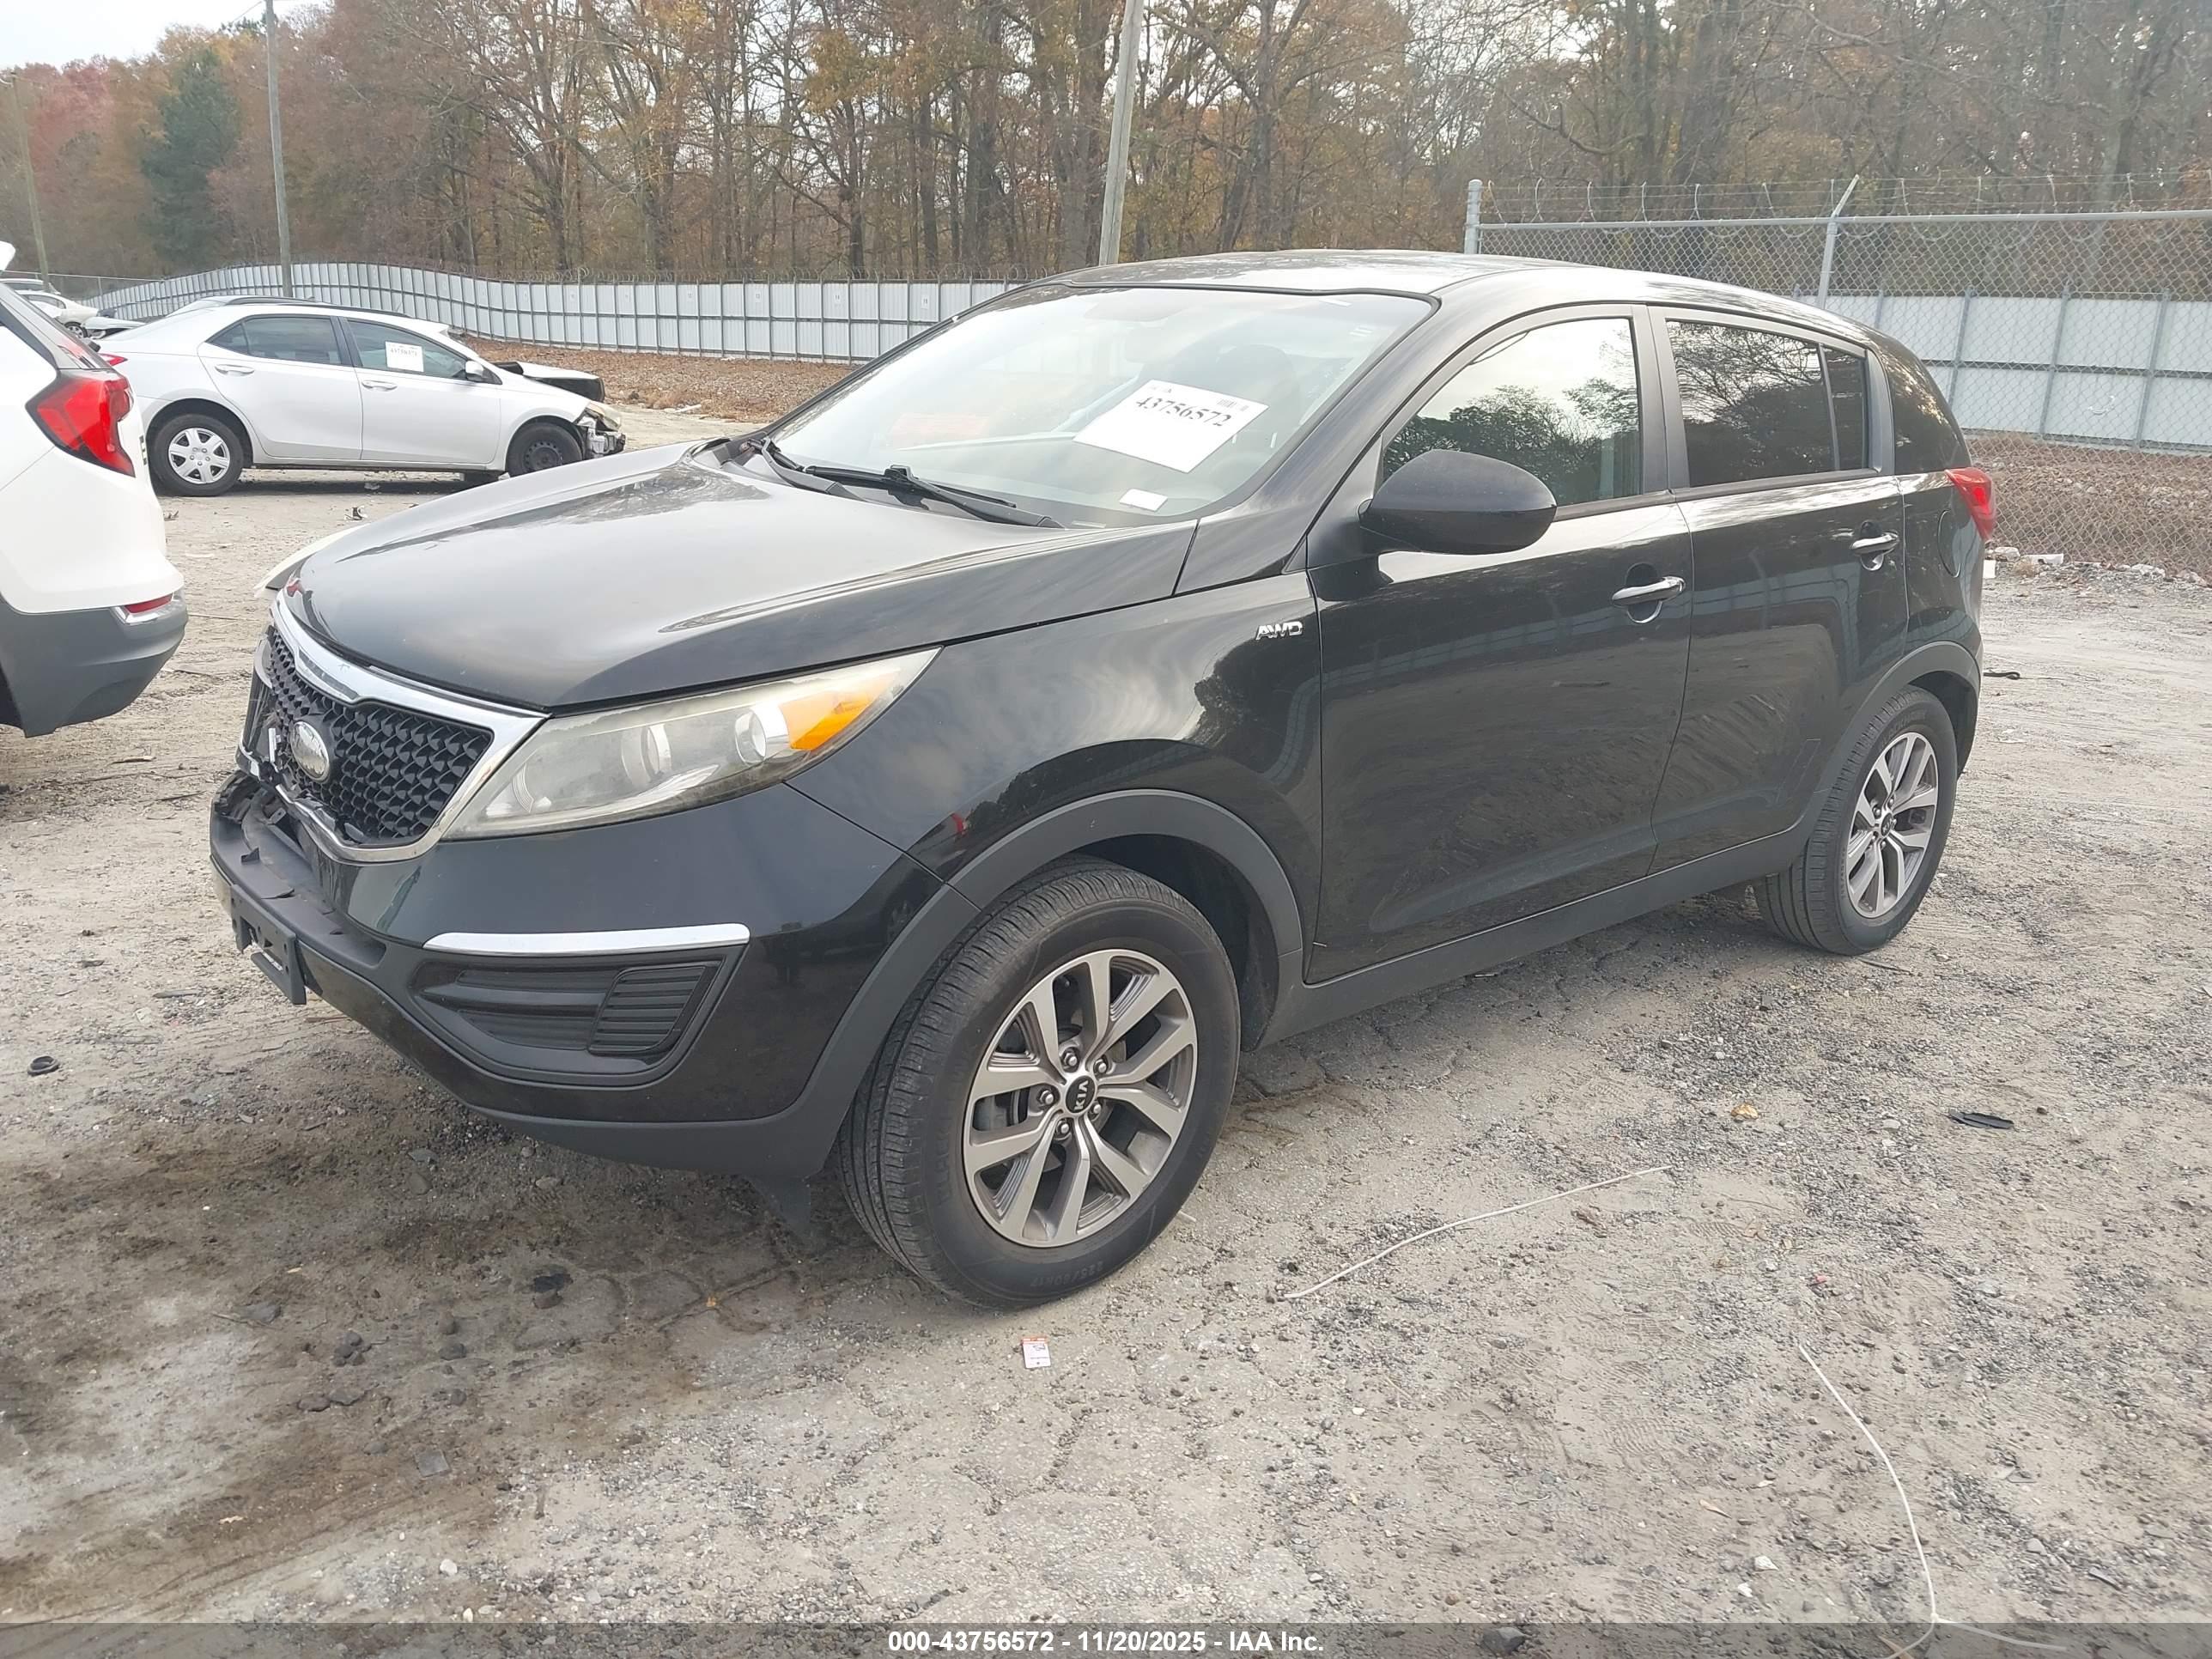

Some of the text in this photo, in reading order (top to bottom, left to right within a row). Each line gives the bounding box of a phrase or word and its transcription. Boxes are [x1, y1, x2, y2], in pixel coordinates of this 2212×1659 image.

[1134, 396, 1233, 428] 43756572
[1255, 621, 1304, 641] AWD
[1073, 1080, 1090, 1111] KIA
